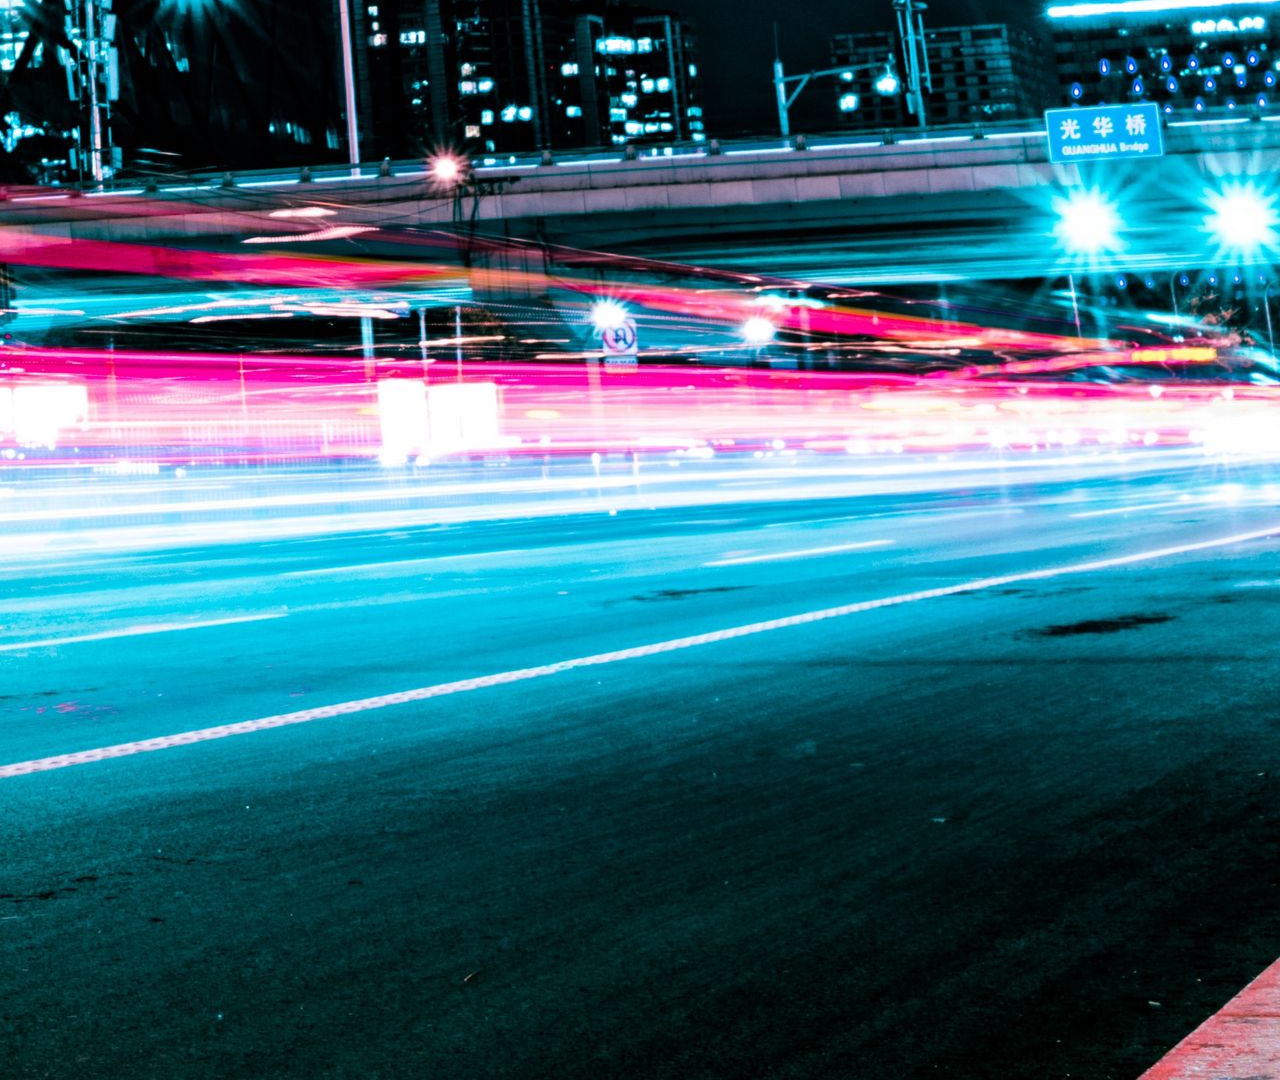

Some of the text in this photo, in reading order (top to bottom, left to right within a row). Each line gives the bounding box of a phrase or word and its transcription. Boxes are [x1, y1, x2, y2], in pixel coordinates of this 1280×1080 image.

[1060, 114, 1147, 140] 光华桥
[1061, 141, 1149, 156] GUANGHUA Bridge
